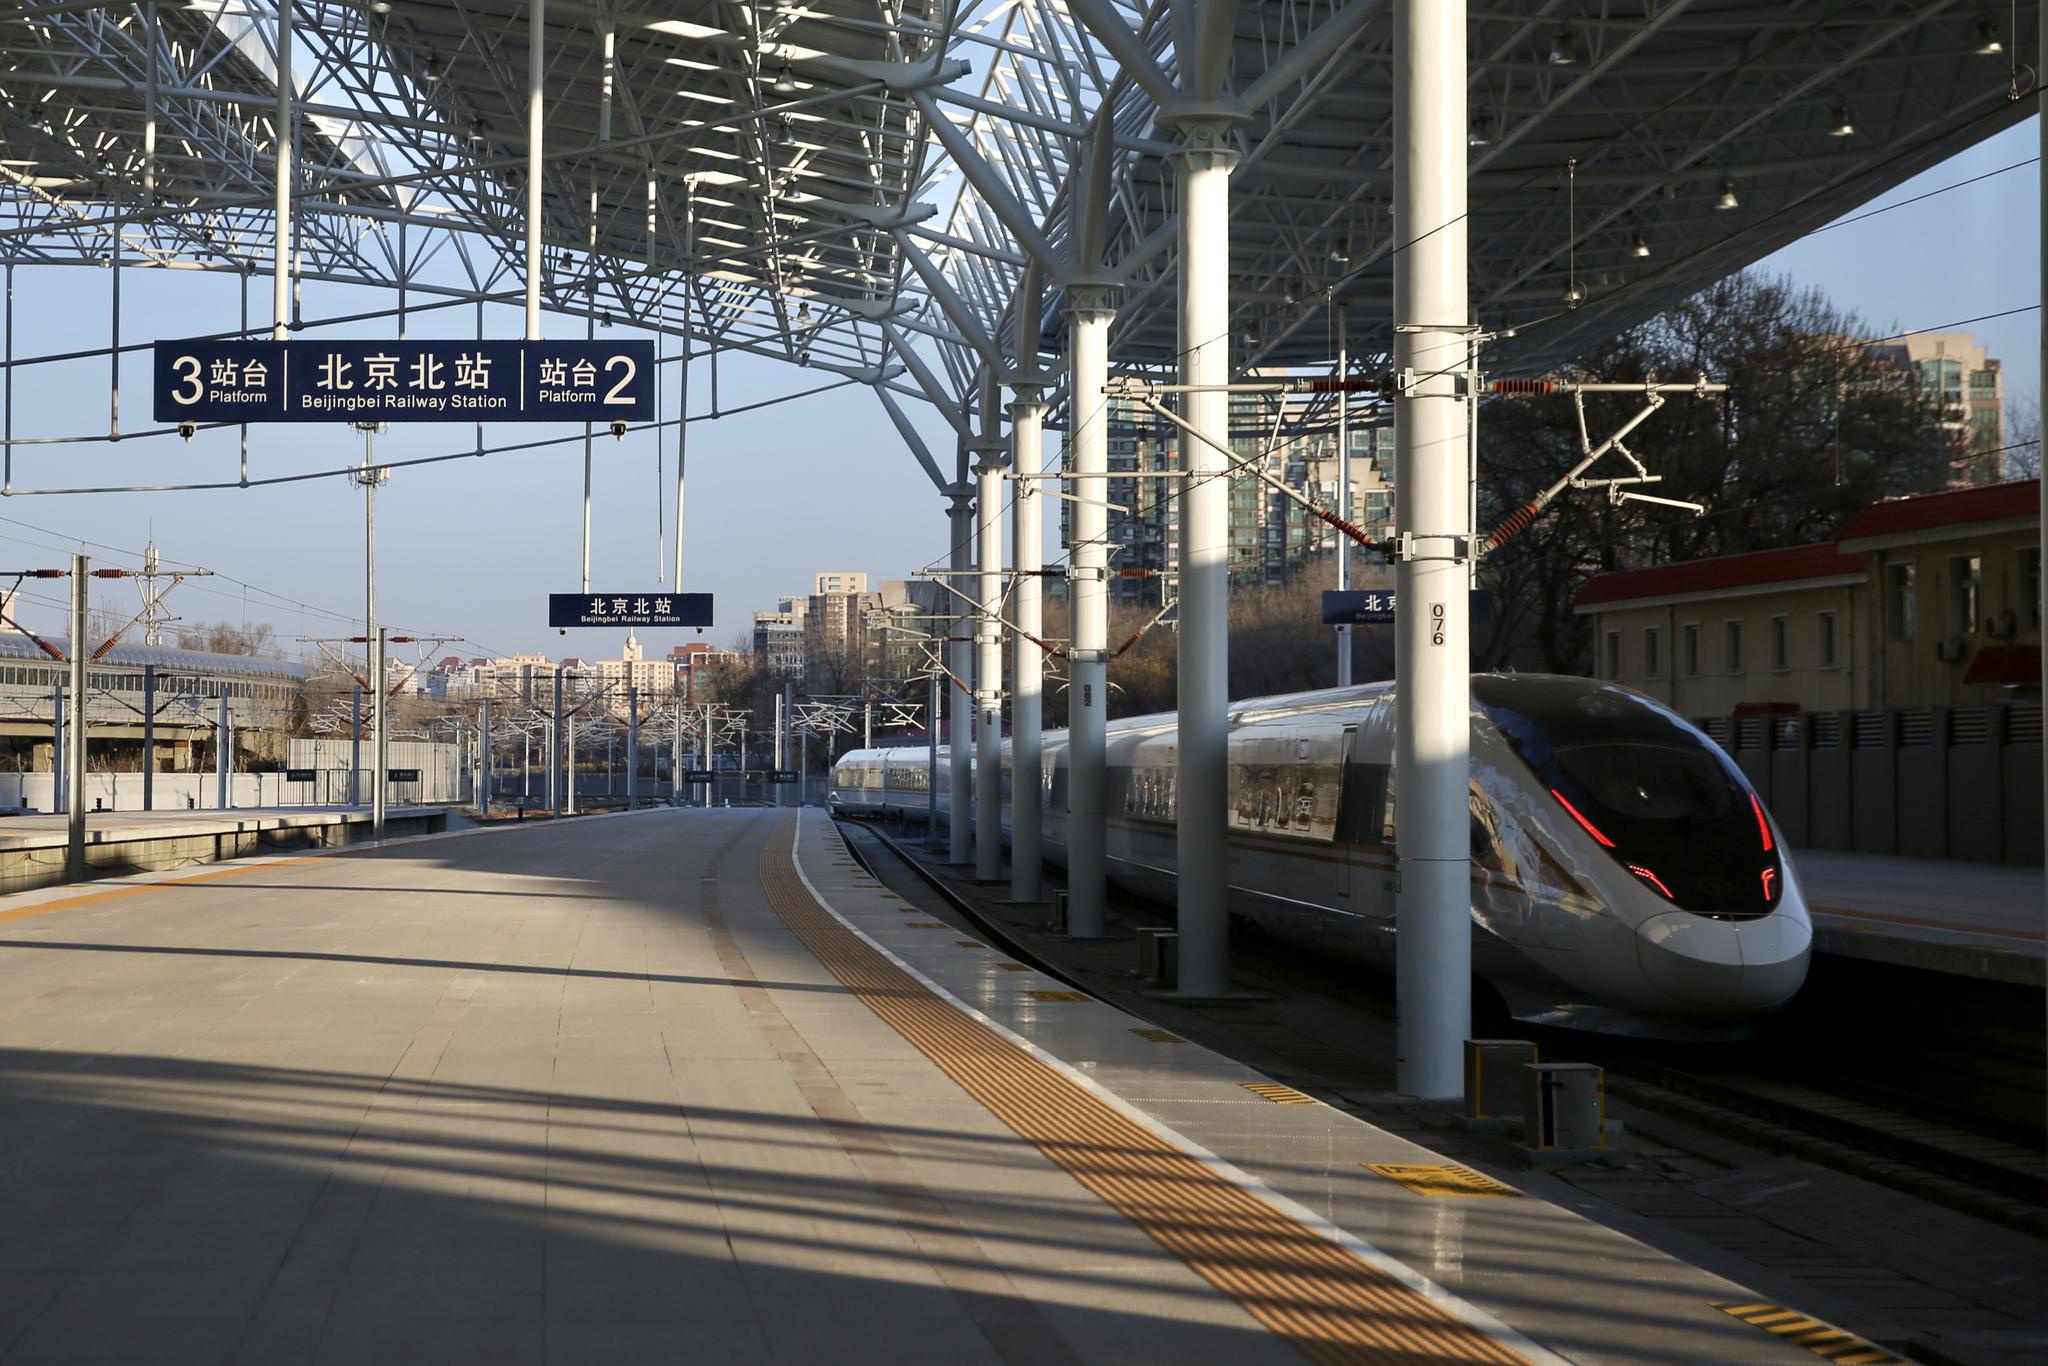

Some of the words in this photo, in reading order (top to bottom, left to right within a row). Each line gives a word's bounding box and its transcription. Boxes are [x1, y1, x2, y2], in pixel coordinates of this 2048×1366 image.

[171, 355, 204, 405] 3
[210, 358, 268, 388] 站台
[316, 352, 492, 390] 北京北站
[539, 357, 597, 387] 站台
[603, 355, 636, 405] 2
[210, 390, 267, 403] Platform
[302, 394, 380, 412] Beijingbei
[385, 394, 447, 412] Railway
[451, 394, 507, 408] Station
[539, 390, 596, 403] Platform
[581, 615, 619, 624] Beijingbei
[621, 615, 651, 624] Railway
[653, 615, 681, 623] Station
[590, 597, 672, 614] 北京北站
[1432, 604, 1444, 645] 076
